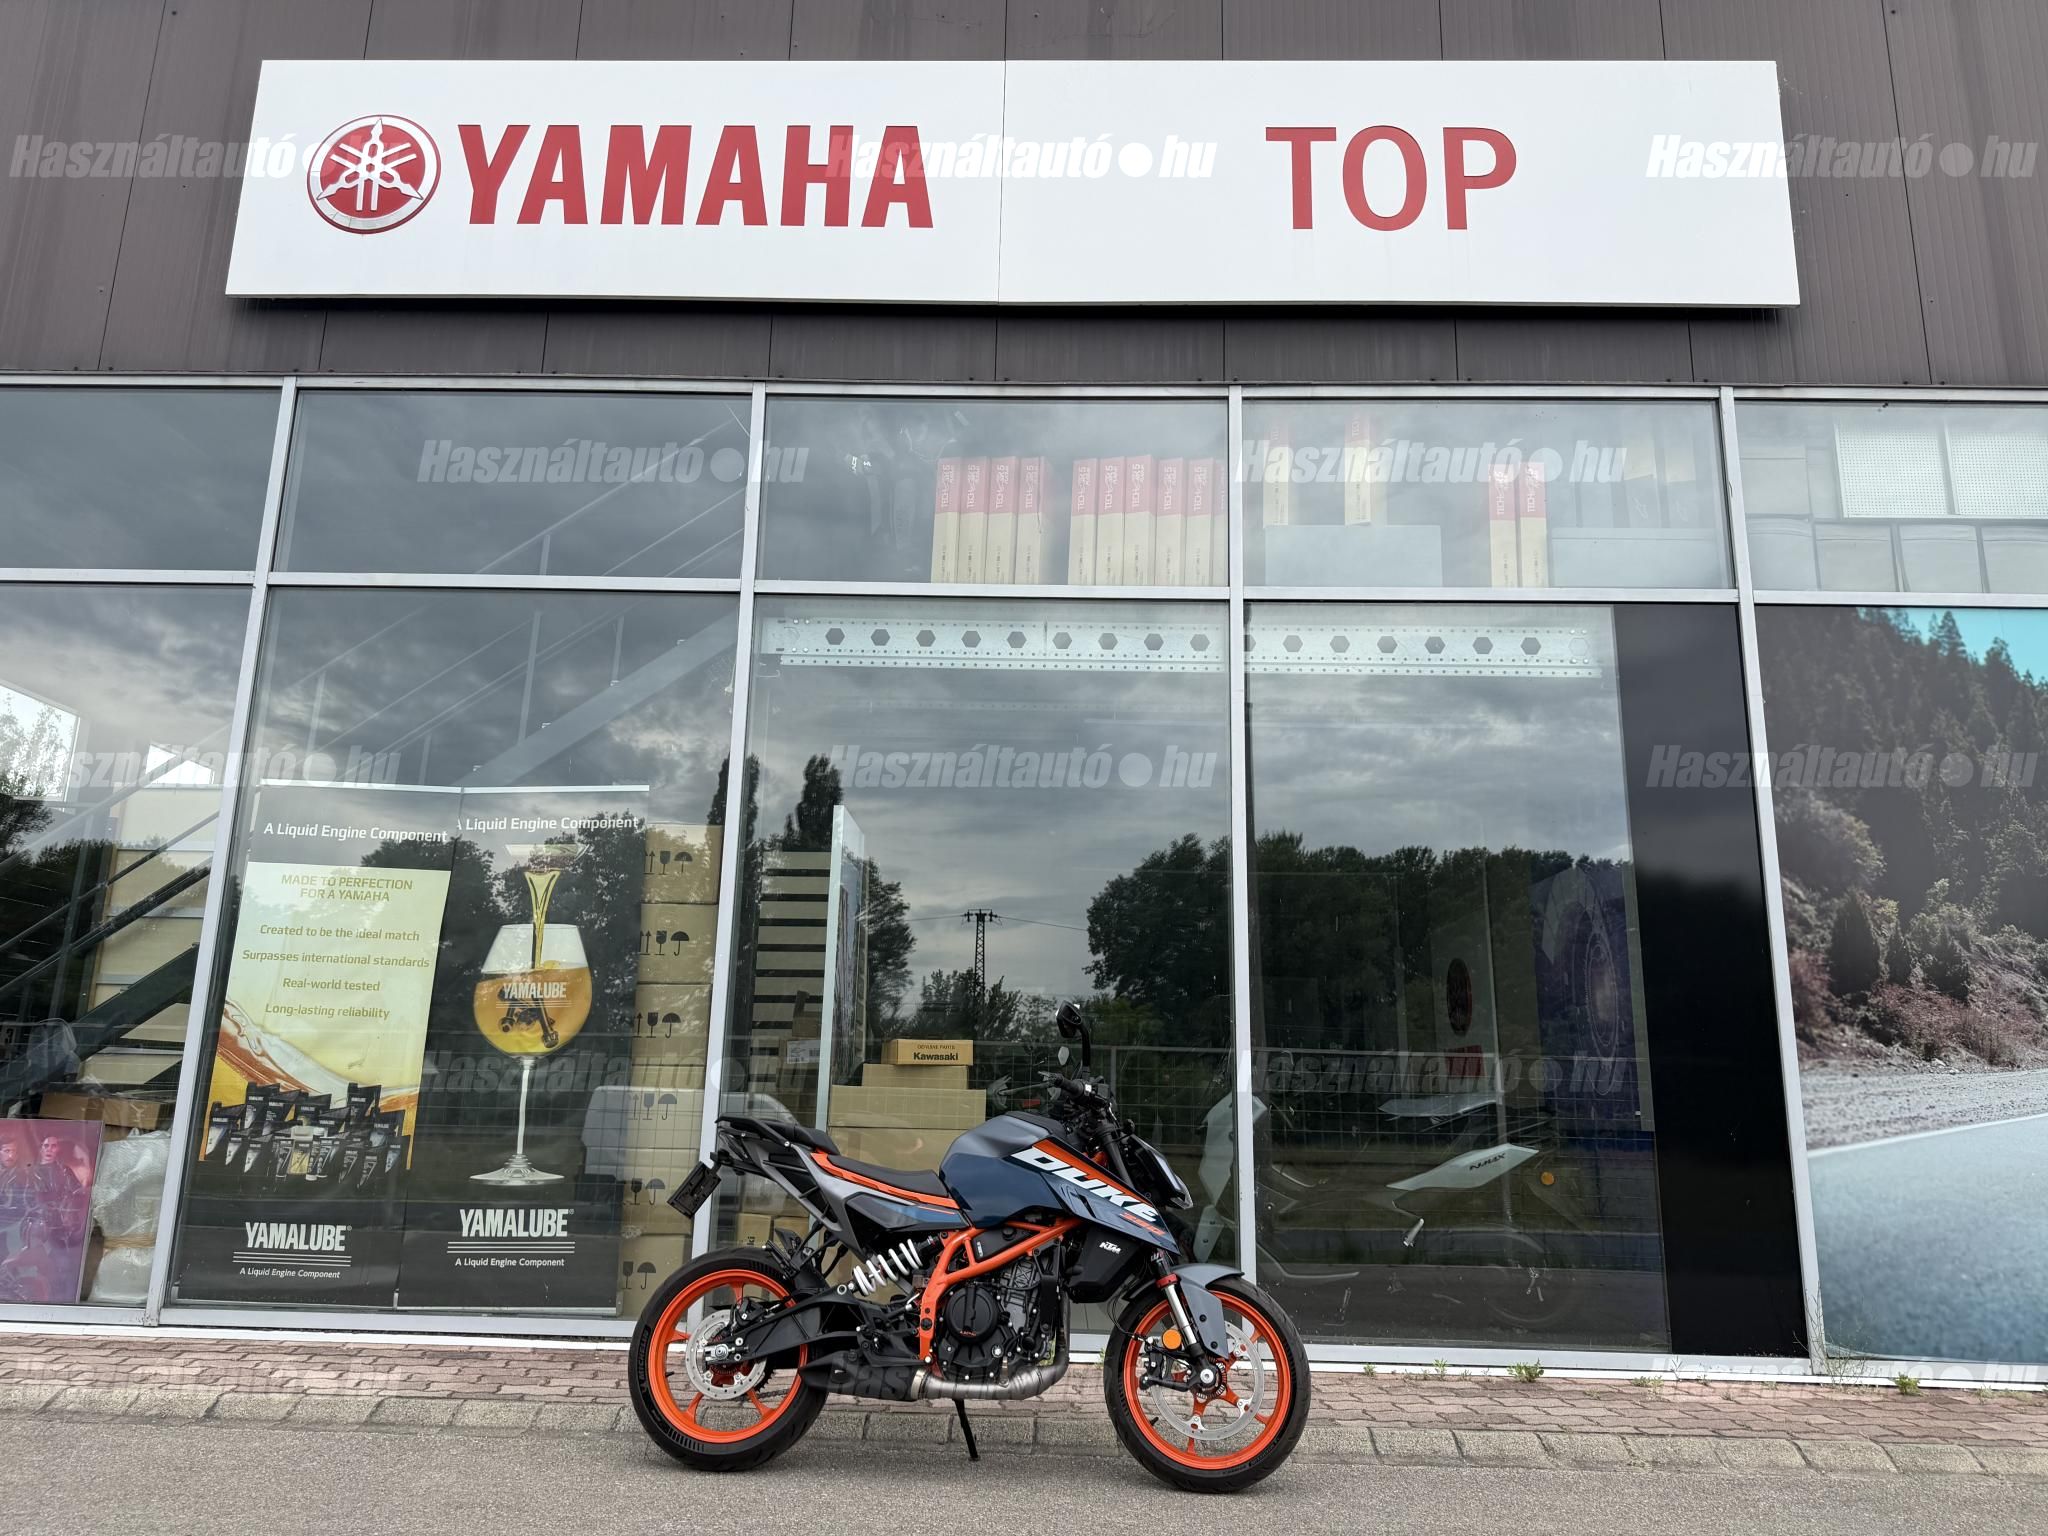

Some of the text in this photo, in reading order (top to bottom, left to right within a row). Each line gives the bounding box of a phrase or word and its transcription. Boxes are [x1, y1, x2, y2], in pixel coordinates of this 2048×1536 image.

[458, 125, 933, 228] YAMAHA
[1265, 125, 1517, 231] TOP
[466, 818, 507, 833] Liquid
[511, 817, 557, 832] Engine
[561, 816, 639, 832] Component
[264, 823, 448, 843] A Liquid Engine Component
[281, 874, 413, 890] MADE TO PERFECTION
[300, 888, 390, 901] FOR A YAMAHA
[260, 924, 420, 941] Created to be the ideal match
[242, 950, 430, 968] Surpasses international standards
[283, 978, 380, 991] Real-world tested
[503, 982, 568, 999] YAMALUBE
[265, 1004, 390, 1020] Long-lasting reliability
[913, 1051, 959, 1061] Kawasaki
[1010, 1146, 1159, 1222] DUKE
[1099, 1241, 1122, 1255] KTM
[455, 1258, 565, 1269] A Liquid Engine Component
[239, 1267, 340, 1280] A Liquid Engine Component
